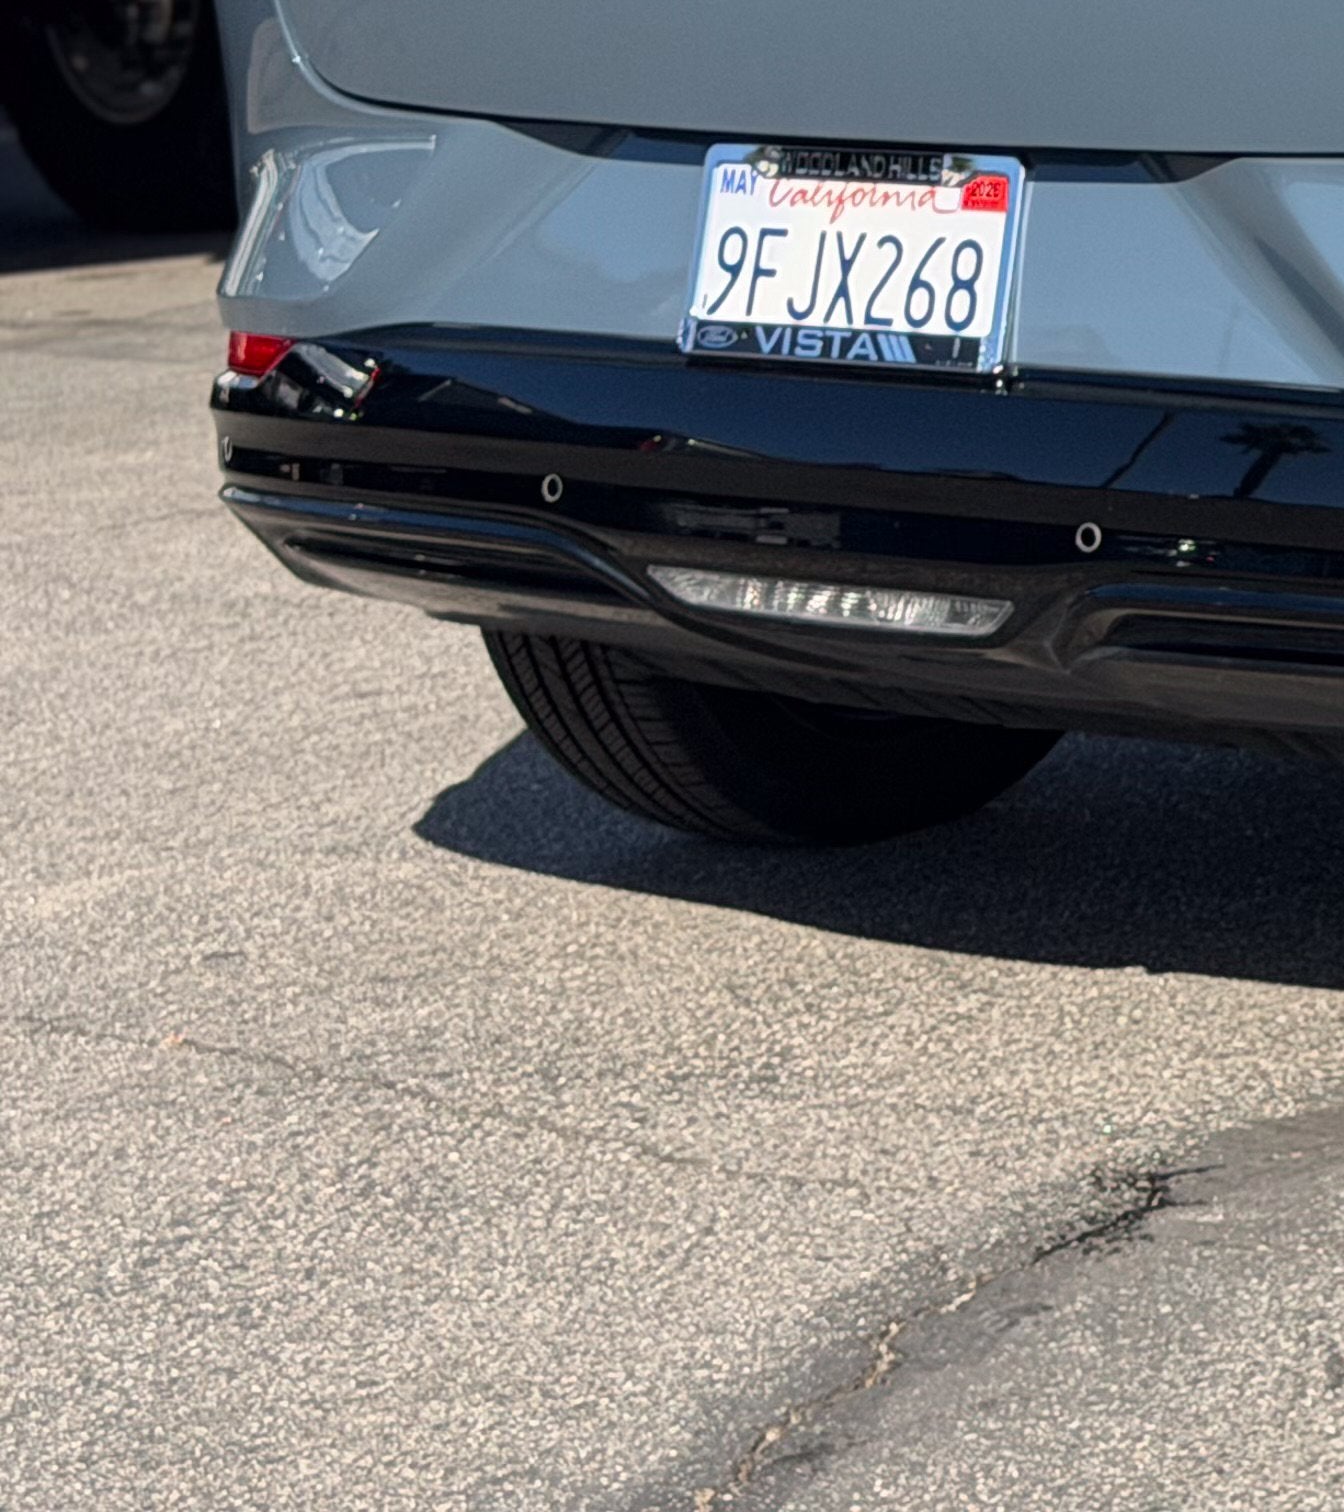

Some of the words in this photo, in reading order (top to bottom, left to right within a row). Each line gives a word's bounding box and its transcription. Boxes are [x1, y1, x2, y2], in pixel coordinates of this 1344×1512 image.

[720, 168, 758, 196] MAY
[781, 151, 887, 178] WOODLAND
[889, 155, 943, 181] HILLS
[769, 178, 959, 225] California
[706, 226, 983, 331] 9FJX268
[755, 326, 879, 362] VISTA
